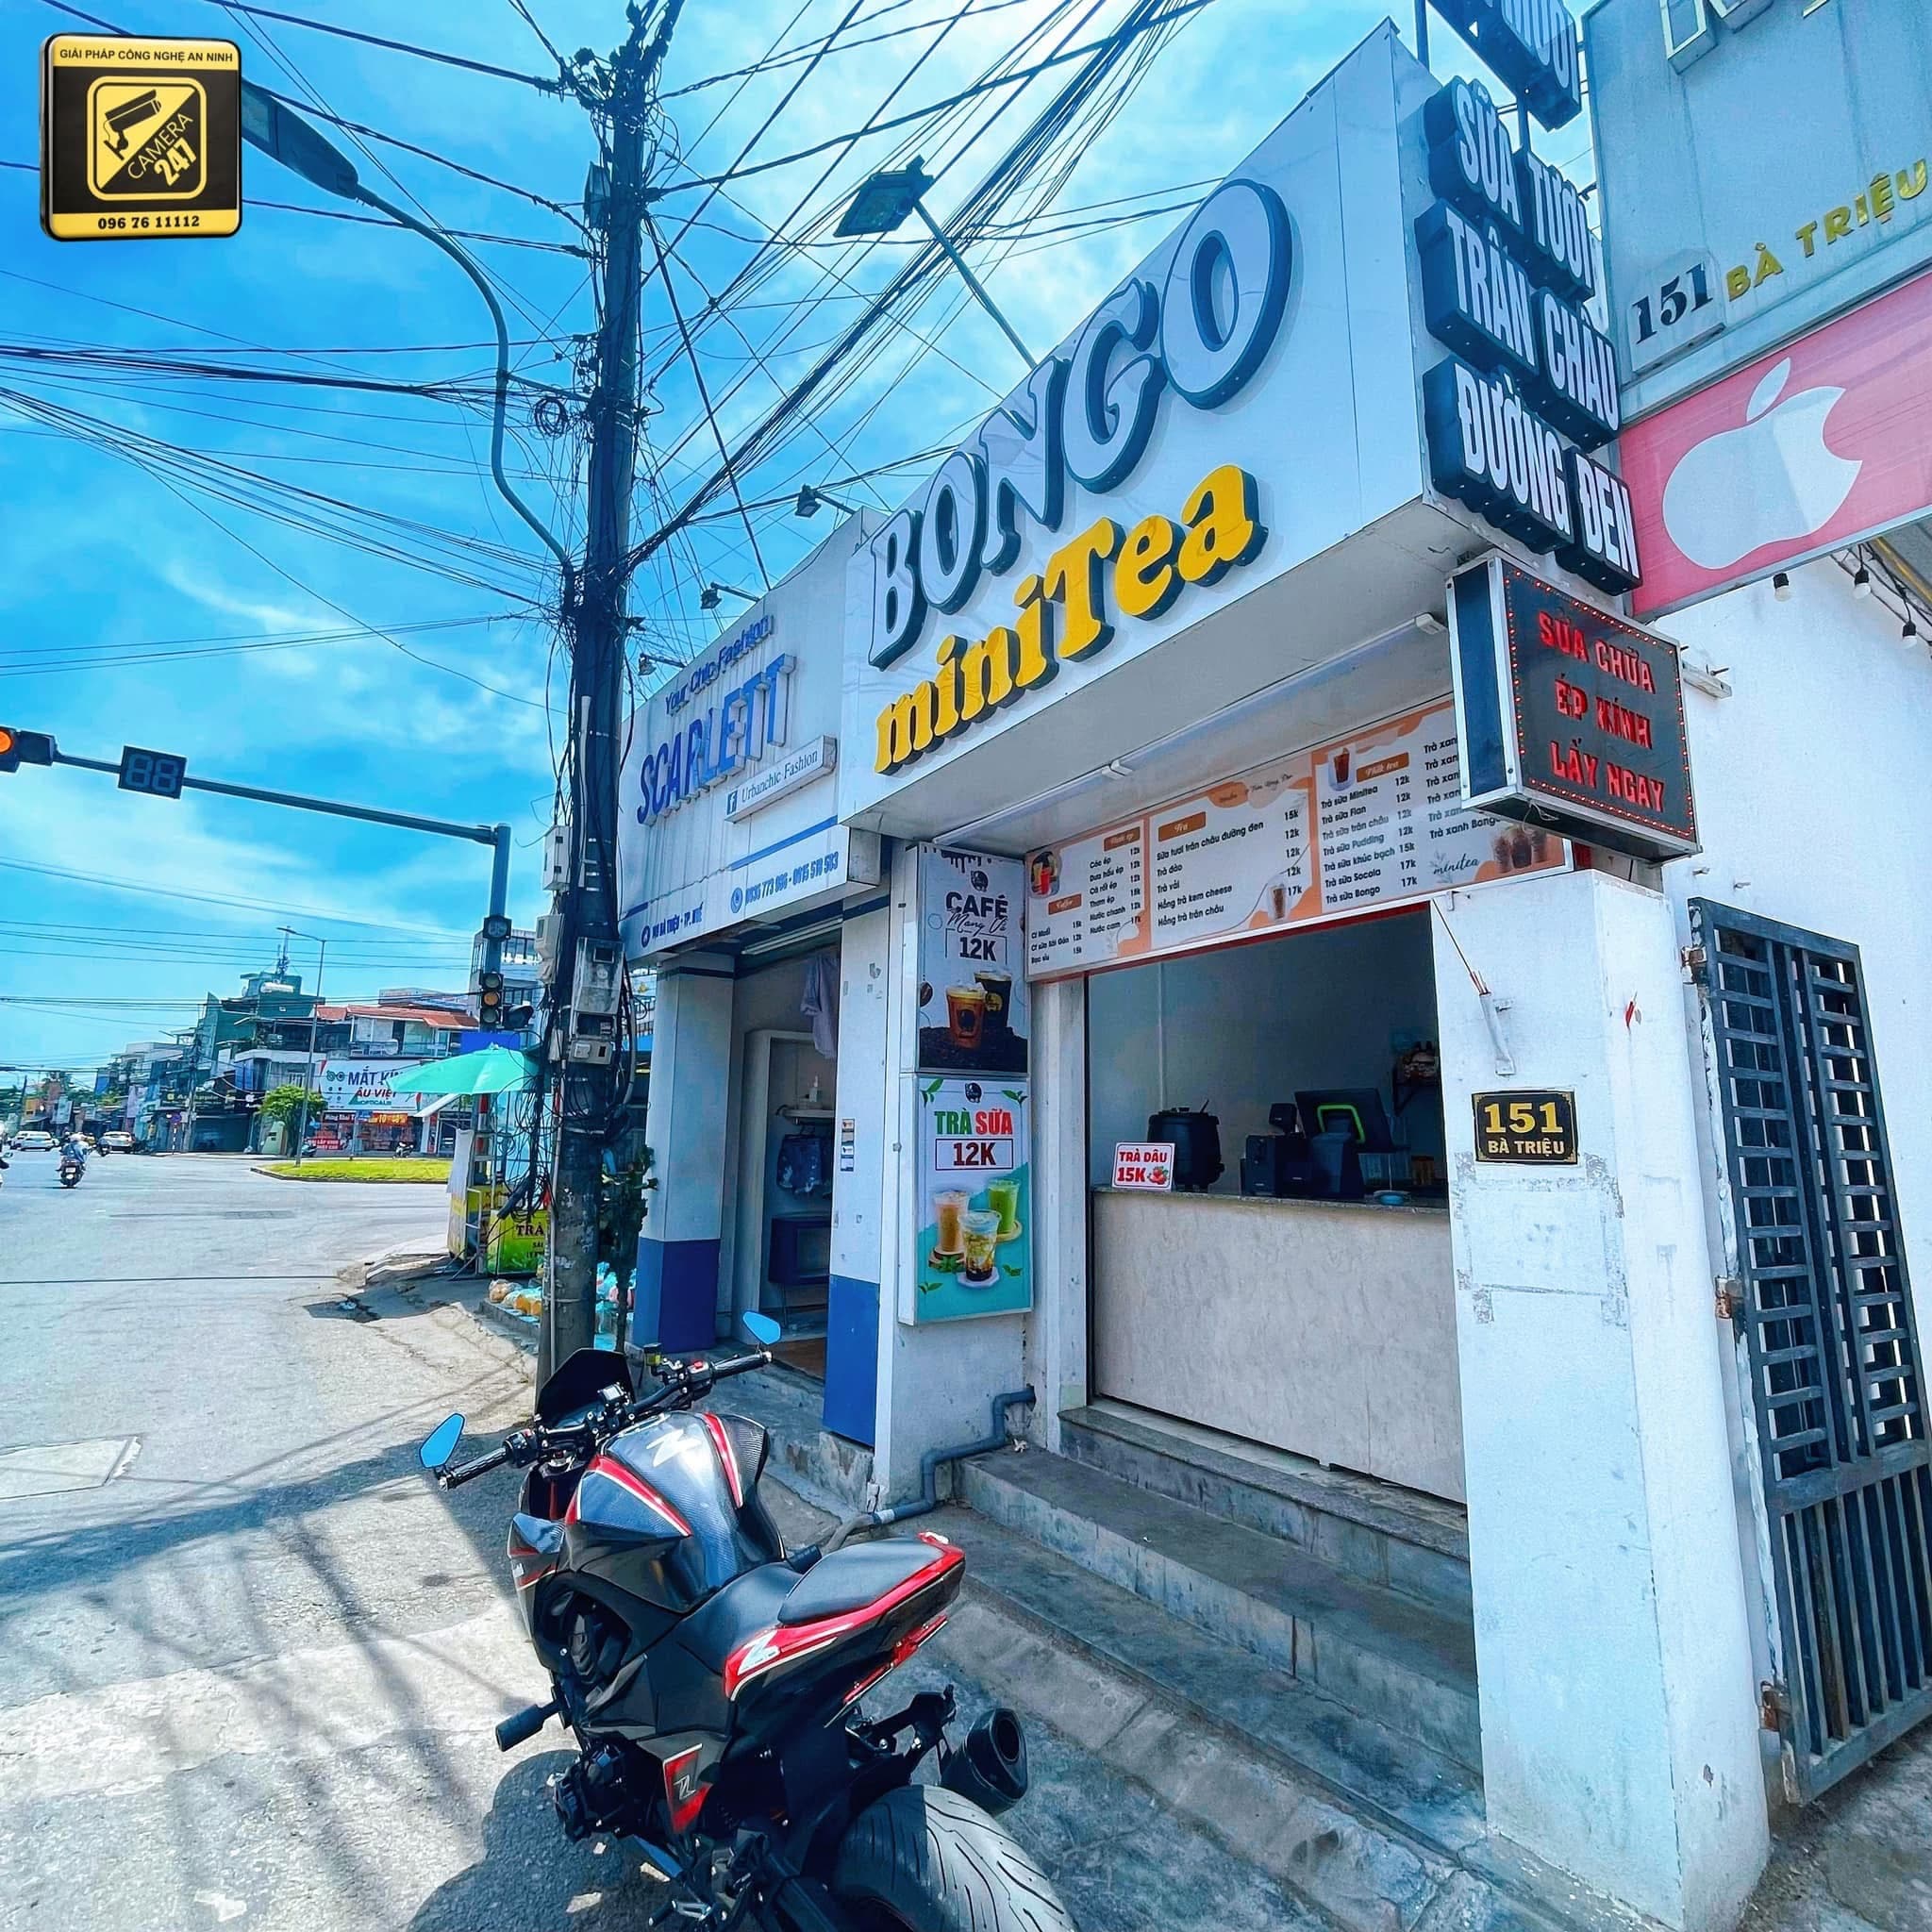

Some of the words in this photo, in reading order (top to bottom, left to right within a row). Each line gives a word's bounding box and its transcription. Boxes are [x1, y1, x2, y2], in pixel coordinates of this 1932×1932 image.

[1456, 83, 1521, 226] SỮA
[1527, 153, 1591, 289] TƯƠI
[1632, 263, 1715, 345] 151
[1725, 242, 1784, 302] BÀ
[1796, 158, 1929, 258] TRIỆU
[1445, 207, 1538, 366] TRÂN
[868, 178, 1289, 669] BONGO
[1456, 364, 1572, 531] ĐƯỜNG
[1574, 452, 1641, 580] ĐEN
[874, 464, 1267, 775] miniTea
[666, 683, 689, 716] Your
[716, 615, 774, 676] Fashion
[1555, 674, 1589, 720] ÉP
[1596, 695, 1652, 749] KÍNH
[637, 653, 796, 827] SCARLETT
[1424, 742, 1437, 754] Trà
[1440, 738, 1457, 749] xan
[741, 771, 781, 803] Urbanchic
[784, 751, 818, 779] Fashion
[1424, 759, 1439, 770] Trà
[1441, 755, 1458, 765] xan
[1550, 738, 1598, 789] LẤY
[1607, 762, 1665, 812] NGAY
[1321, 799, 1332, 809] Trà
[1334, 795, 1347, 806] sữa
[1395, 775, 1410, 787] 12k
[1426, 775, 1440, 788] Trà
[1442, 771, 1460, 783] xan
[1322, 814, 1333, 824] Trà
[1335, 811, 1348, 821] sữa
[1350, 806, 1366, 817] Flan
[1396, 792, 1410, 803] 12k
[1427, 793, 1441, 805] Trà
[1443, 789, 1461, 800] xan
[1201, 835, 1220, 847] châu
[1222, 827, 1245, 841] đường
[1248, 822, 1264, 833] đen
[1284, 809, 1298, 821] 15k
[1323, 830, 1334, 841] Trà
[1369, 815, 1389, 827] châu
[1397, 809, 1412, 820] 12k
[1428, 810, 1442, 823] Trà
[1430, 828, 1442, 840] Trà
[1446, 822, 1469, 836] xanh
[1157, 867, 1167, 876] Trà
[1169, 864, 1182, 874] đào
[1285, 828, 1299, 840] 12k
[1323, 846, 1334, 857] Trà
[1337, 843, 1350, 854] sữa
[1352, 834, 1384, 849] Pudding
[1398, 825, 1413, 837] 12k
[1158, 884, 1168, 894] Trà
[1287, 847, 1300, 858] 12k
[1288, 866, 1301, 876] 12k
[1324, 862, 1336, 872] Trà
[1338, 858, 1351, 869] sữa
[1374, 847, 1395, 860] bạch
[1399, 842, 1415, 854] 15k
[1324, 878, 1337, 889] Trà
[1339, 875, 1352, 885] sữa
[1354, 869, 1381, 882] Socola
[1400, 859, 1416, 871] 17k
[946, 891, 1008, 920] CAFÉ
[1206, 905, 1224, 915] châu
[1288, 885, 1302, 896] 17k
[1326, 894, 1338, 904] Trà
[1340, 891, 1353, 901] sữa
[1356, 886, 1380, 898] Bongo
[1402, 876, 1417, 888] 17k
[959, 937, 996, 961] 12K
[935, 1108, 973, 1135] TRÀ
[975, 1109, 1013, 1135] SỮA
[1485, 1102, 1563, 1133] 151
[953, 1142, 996, 1166] 12K
[1120, 1148, 1140, 1161] TRÀ
[1144, 1149, 1167, 1162] DÂU
[1488, 1138, 1509, 1154] BÀ
[1514, 1138, 1564, 1157] TRIỆU
[1117, 1168, 1146, 1182] 15K
